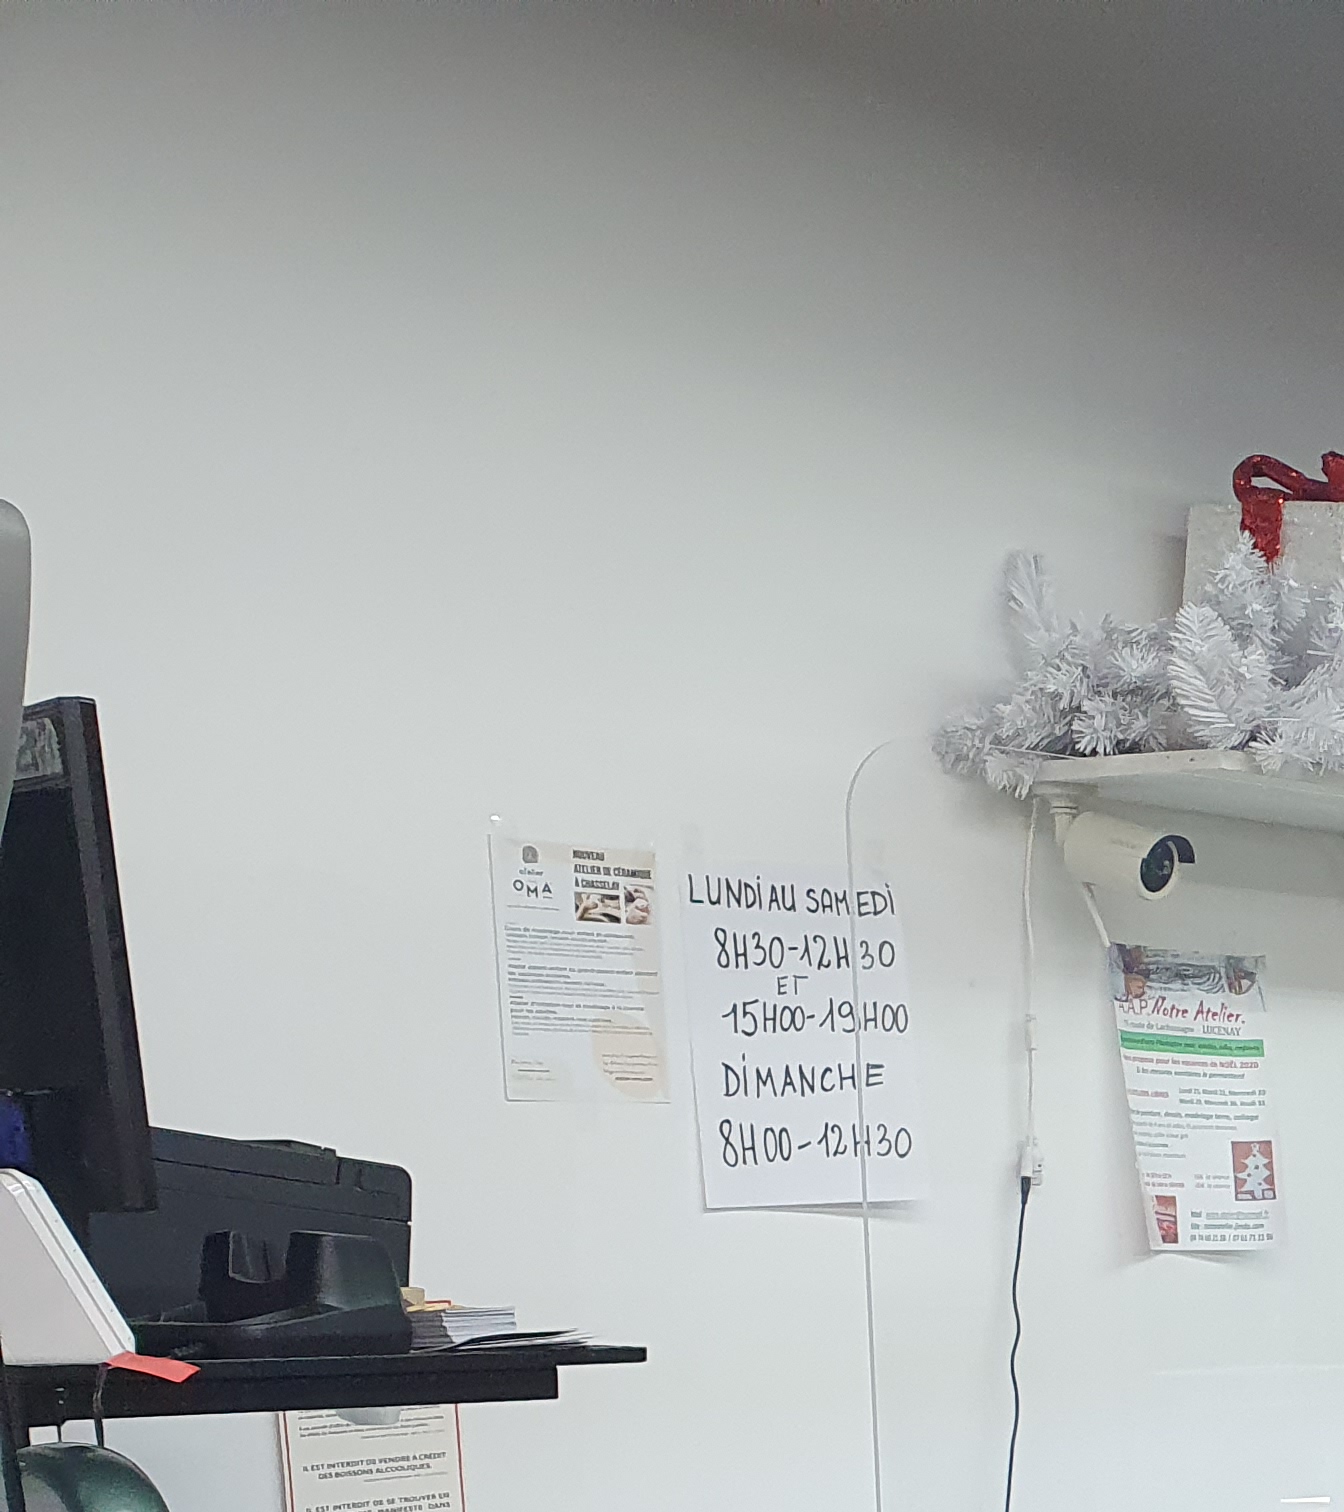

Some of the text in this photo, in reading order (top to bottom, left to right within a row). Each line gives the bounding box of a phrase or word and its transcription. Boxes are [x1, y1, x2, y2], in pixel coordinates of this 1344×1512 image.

[572, 849, 605, 862] NOUVEAU
[573, 863, 601, 875] ATELIER
[512, 879, 553, 899] OMA
[581, 878, 620, 891] CHASSELAY
[767, 884, 796, 913] AU
[776, 974, 809, 996] ET
[1151, 995, 1189, 1020] Notre
[1202, 1024, 1241, 1036] LUCENAY
[310, 1463, 325, 1472] EST
[326, 1459, 364, 1471] INTERDIT
[318, 1471, 334, 1480] DES
[334, 1468, 374, 1479] BOISSONS
[315, 1504, 330, 1512] EST
[332, 1500, 370, 1512] INTERDIT
[397, 1493, 437, 1503] TROUVER
